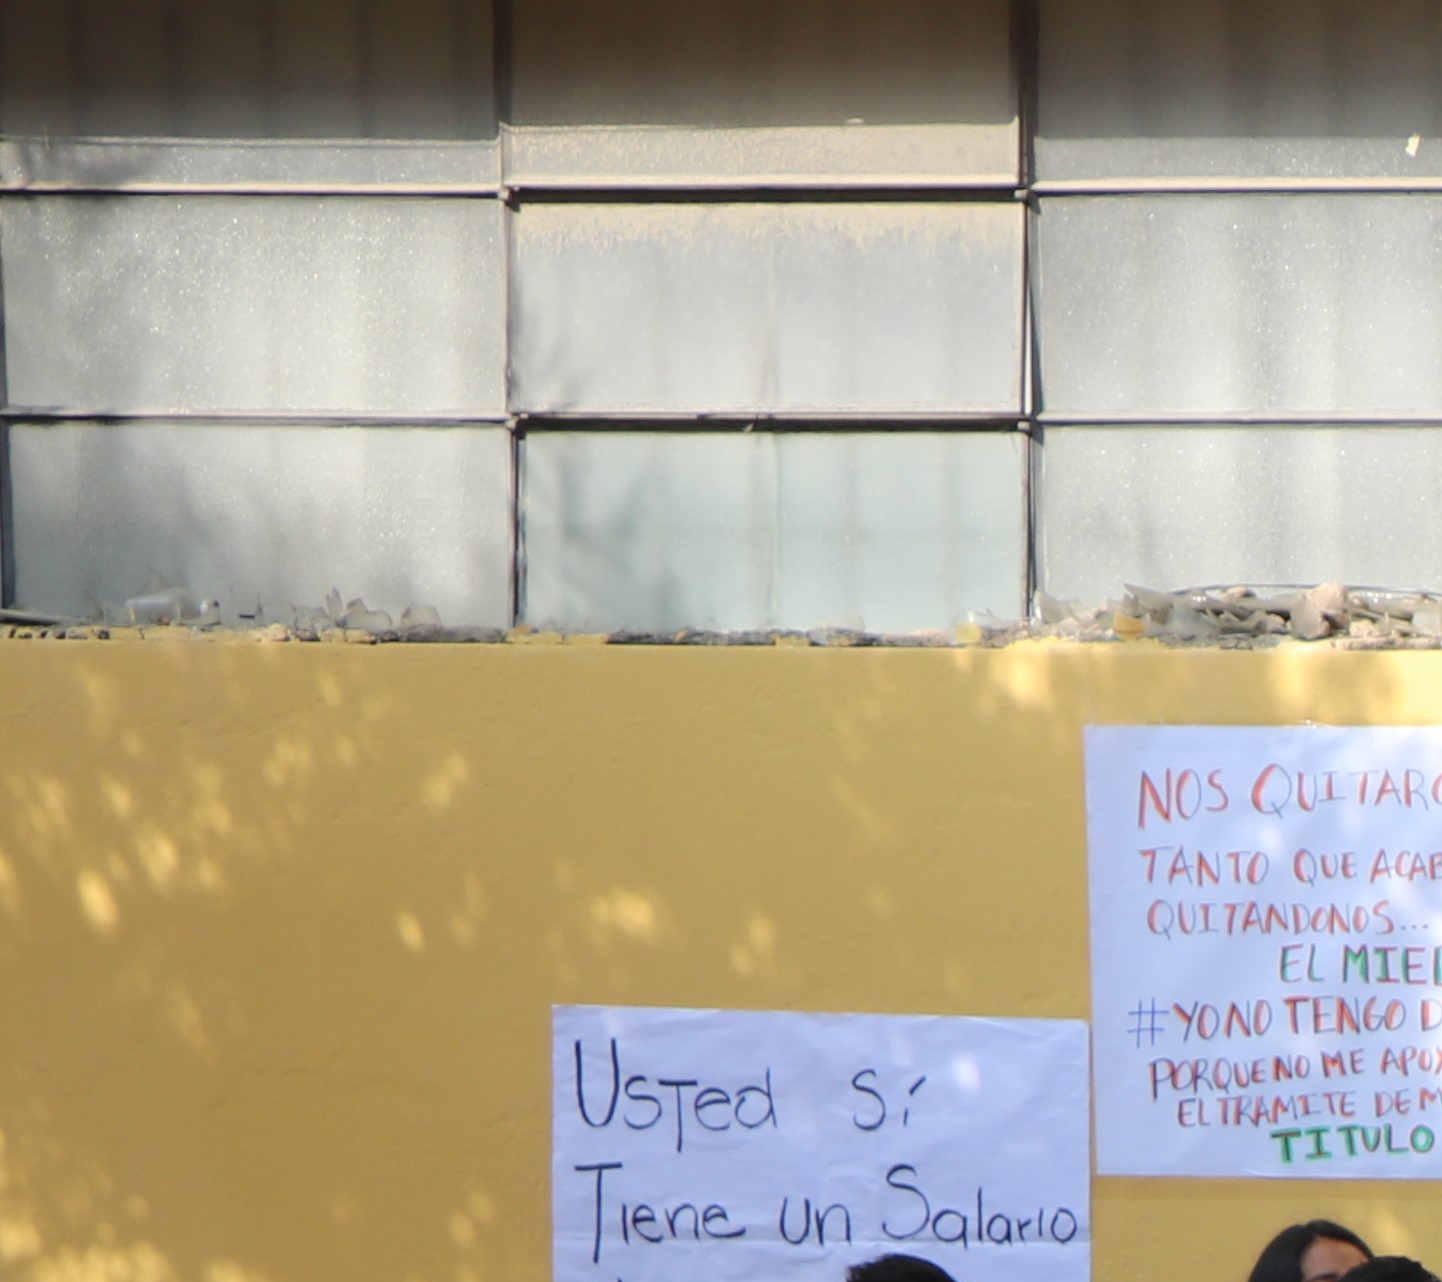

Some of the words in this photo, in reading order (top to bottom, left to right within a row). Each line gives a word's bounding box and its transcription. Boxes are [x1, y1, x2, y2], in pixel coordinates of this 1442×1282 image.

[1138, 768, 1229, 829] NOS
[1138, 846, 1269, 885] TANTO
[1293, 849, 1358, 885] QUE
[1280, 945, 1324, 983] EL
[1284, 997, 1406, 1036] TENGO
[1321, 1048, 1364, 1077] ME
[1271, 1123, 1434, 1163] TITULO
[574, 1161, 747, 1264] Tiene
[882, 1163, 1078, 1249] Salario
